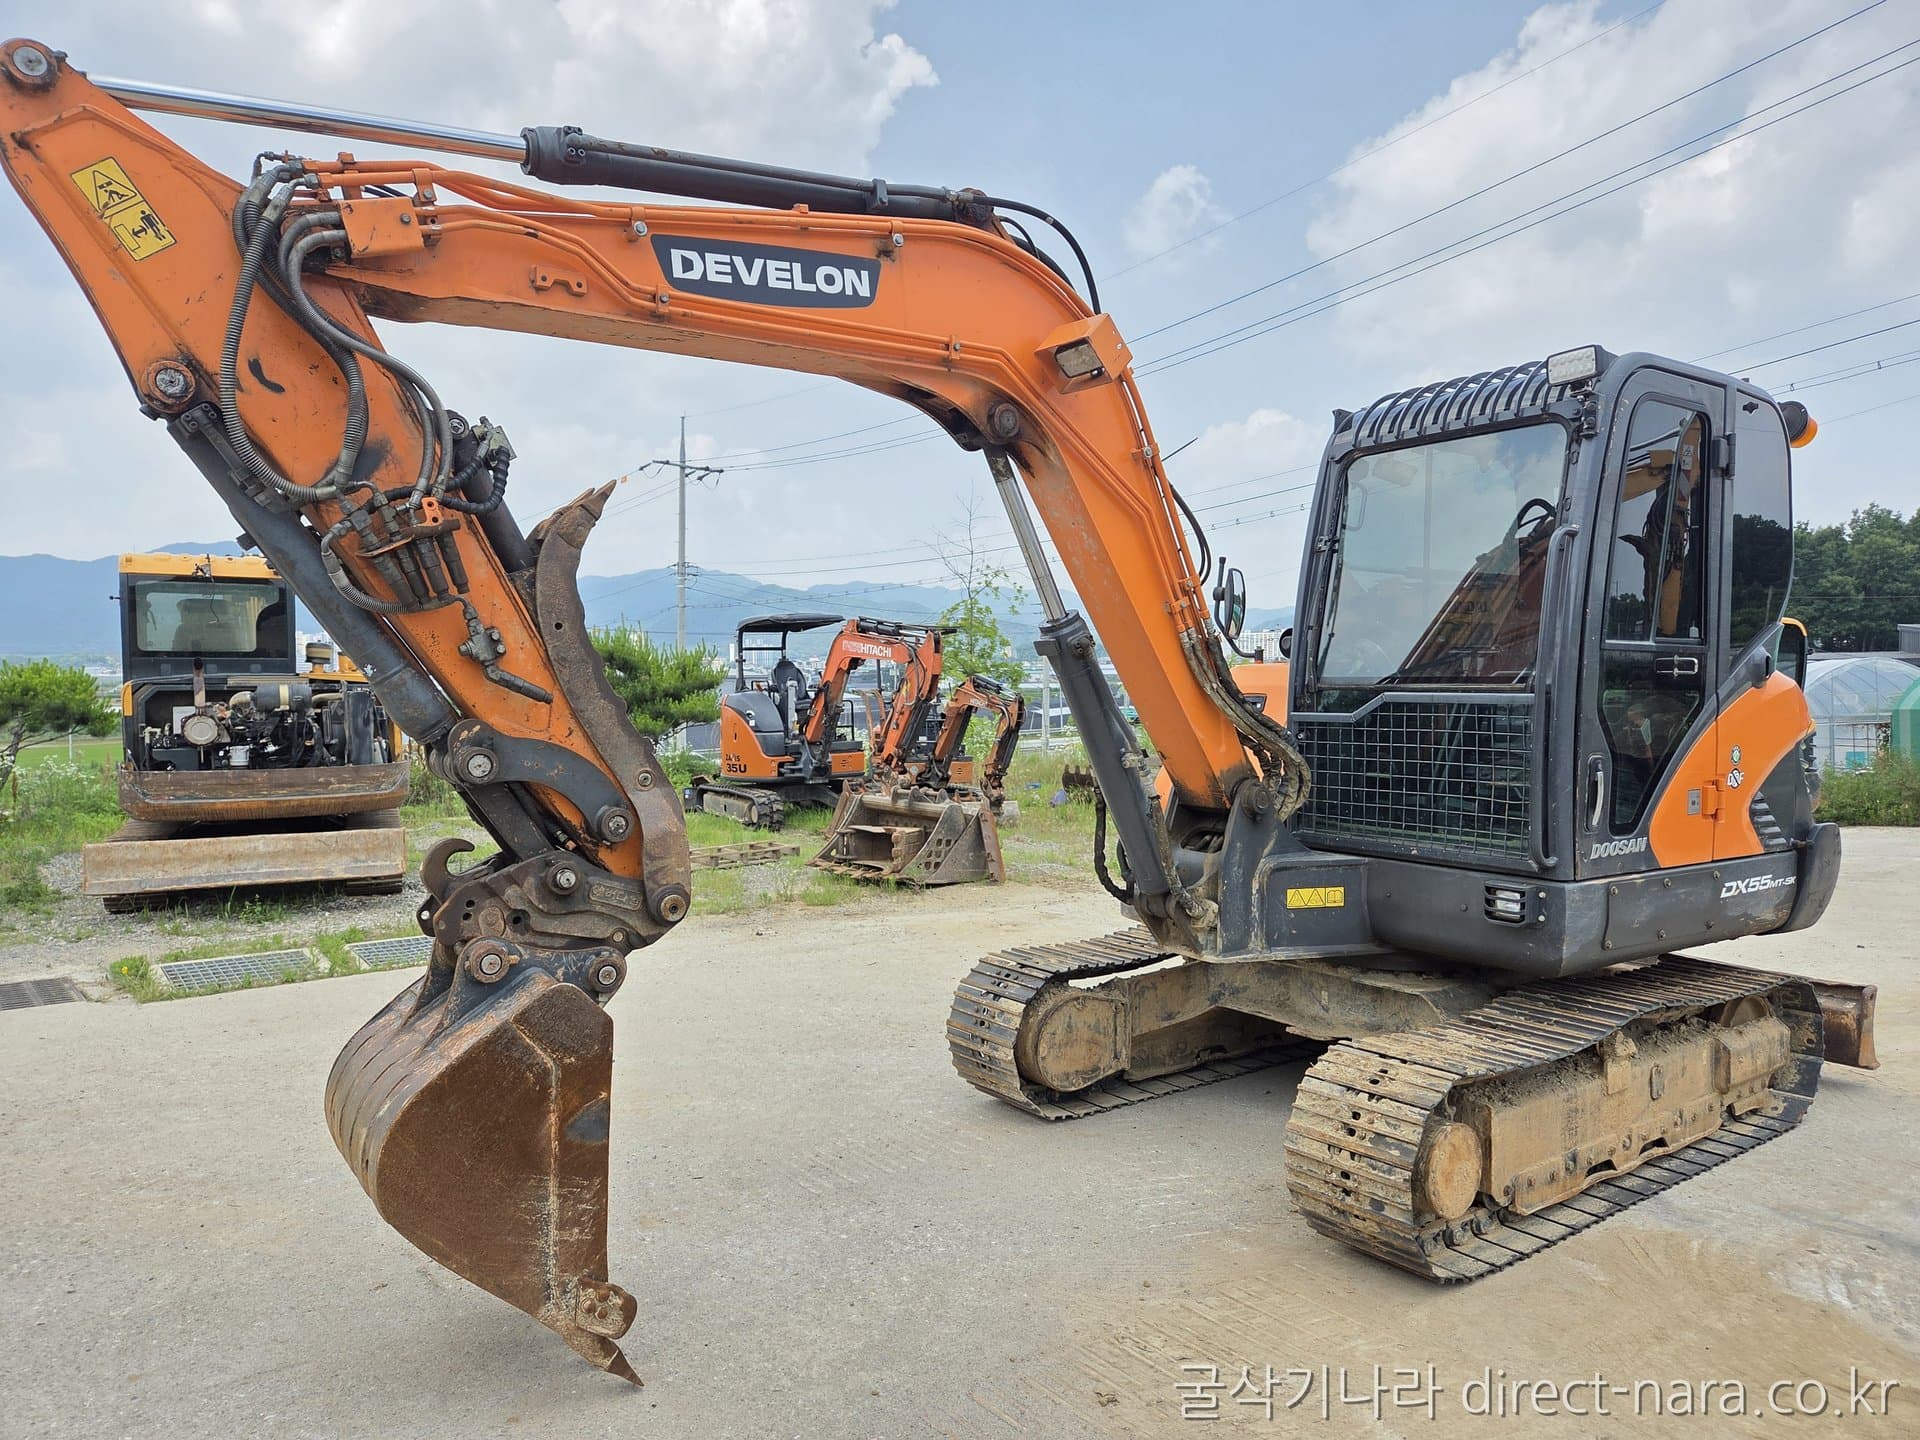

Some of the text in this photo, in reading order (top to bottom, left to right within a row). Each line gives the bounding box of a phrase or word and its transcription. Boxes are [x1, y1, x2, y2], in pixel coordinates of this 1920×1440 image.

[670, 248, 871, 297] DEVELON
[860, 643, 892, 658] HITACHI
[725, 753, 741, 762] ZAIS
[726, 763, 747, 773] 35U
[1590, 836, 1648, 860] DOOSAN
